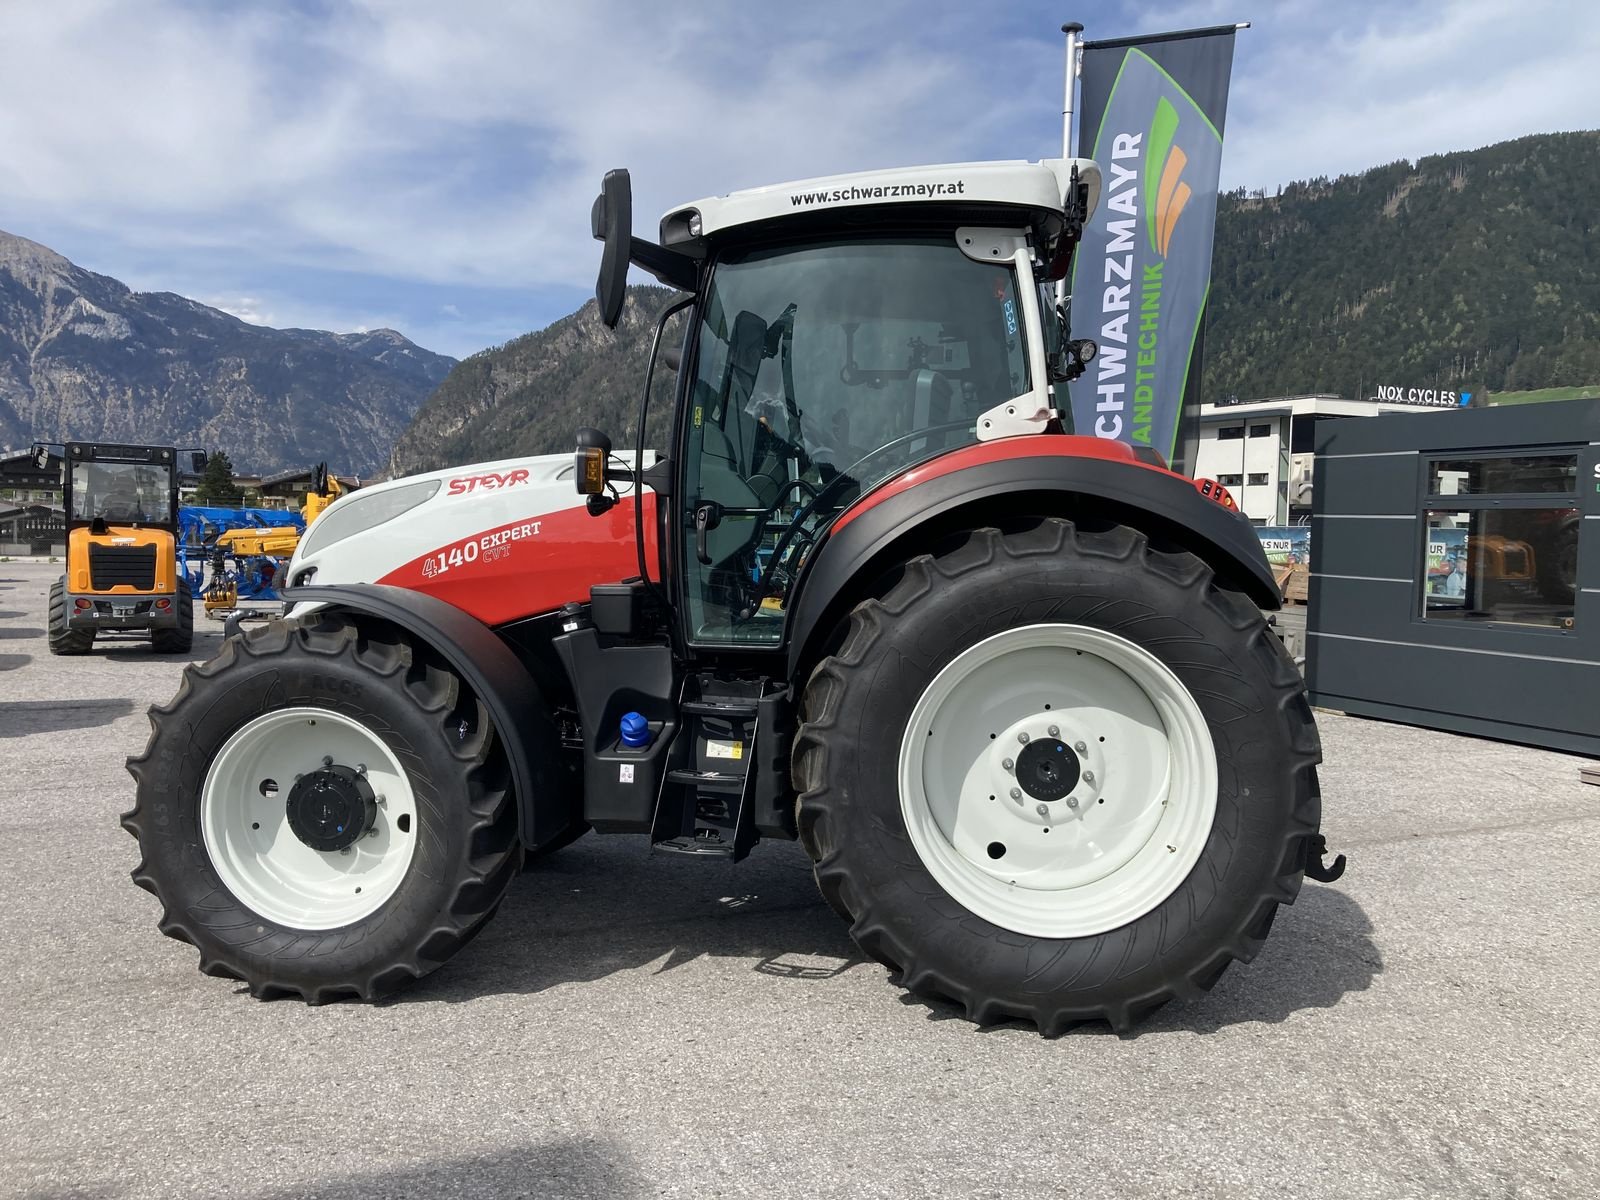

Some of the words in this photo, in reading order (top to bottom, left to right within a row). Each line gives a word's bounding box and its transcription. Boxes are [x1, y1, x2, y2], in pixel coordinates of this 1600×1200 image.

[791, 180, 965, 206] www.schwarzmayr.at
[1095, 132, 1142, 440] CHWARZMAYR
[1132, 261, 1164, 444] ANDTECHNIK
[1377, 385, 1403, 400] NOX
[1408, 388, 1456, 404] CYCLES
[447, 469, 529, 496] STEYR
[422, 541, 478, 578] 4140
[481, 521, 542, 550] EXPERT
[483, 544, 511, 563] CVT
[1273, 541, 1289, 549] NUR
[1429, 545, 1443, 554] UR
